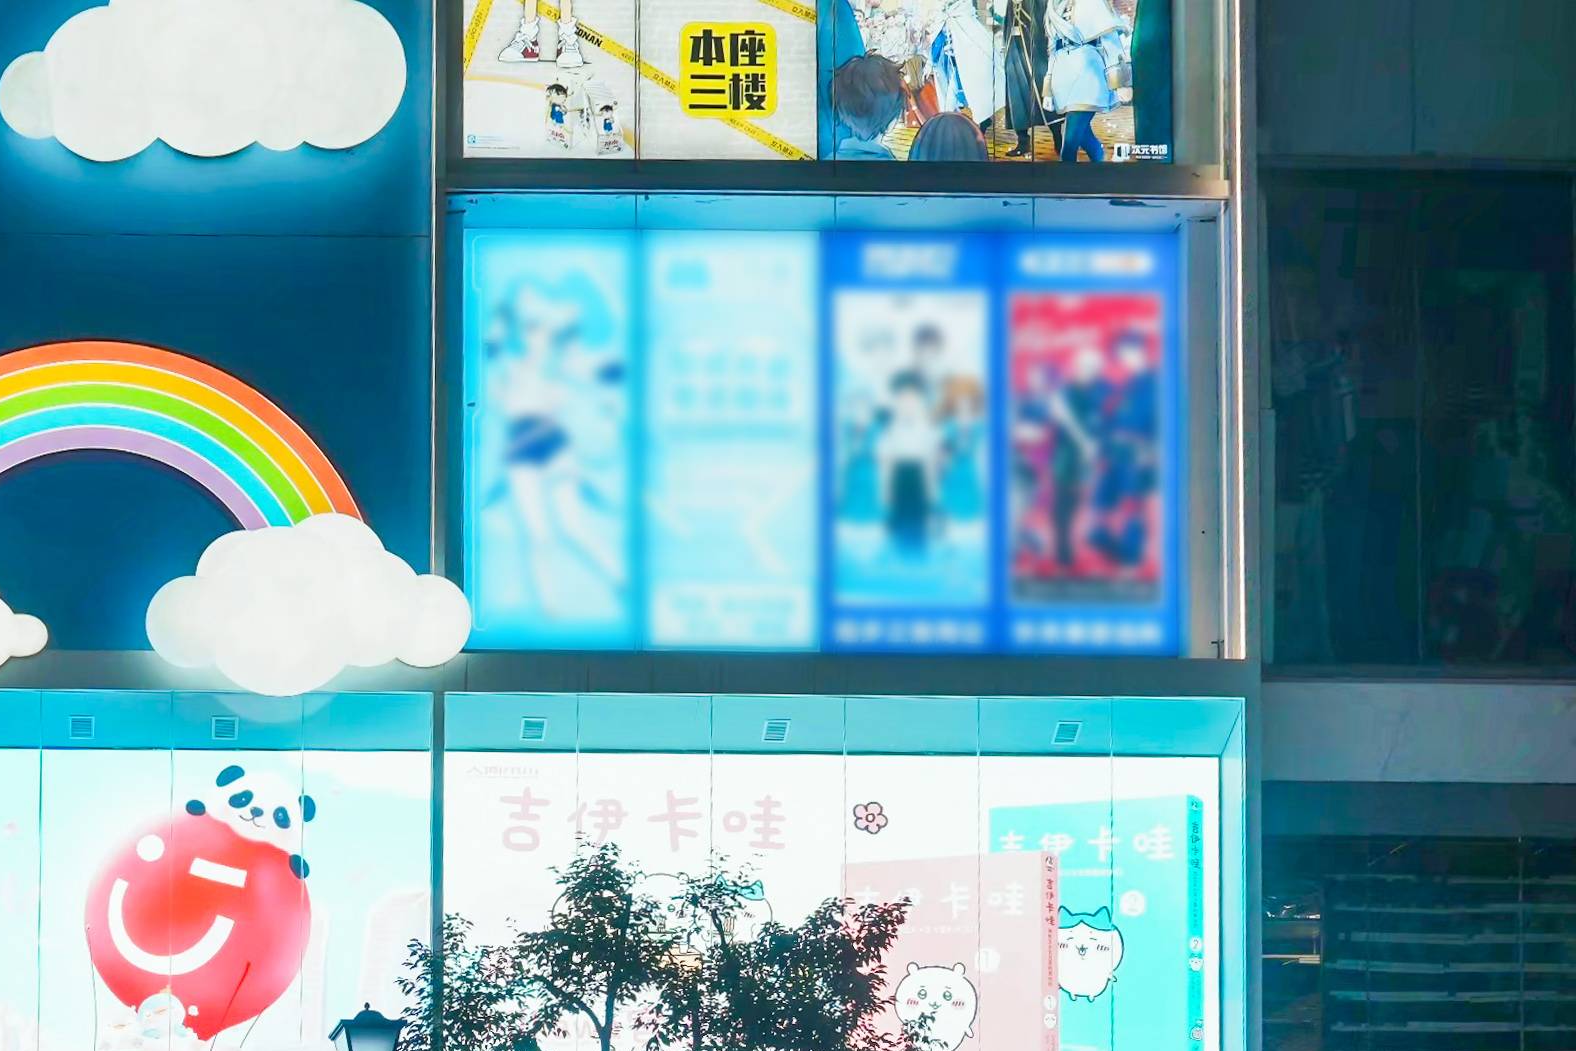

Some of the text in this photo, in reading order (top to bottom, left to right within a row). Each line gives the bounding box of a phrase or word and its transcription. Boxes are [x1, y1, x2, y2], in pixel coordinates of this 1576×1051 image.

[689, 29, 766, 67] 本座
[689, 73, 766, 110] 三楼
[499, 786, 786, 852] 吉伊卡哇
